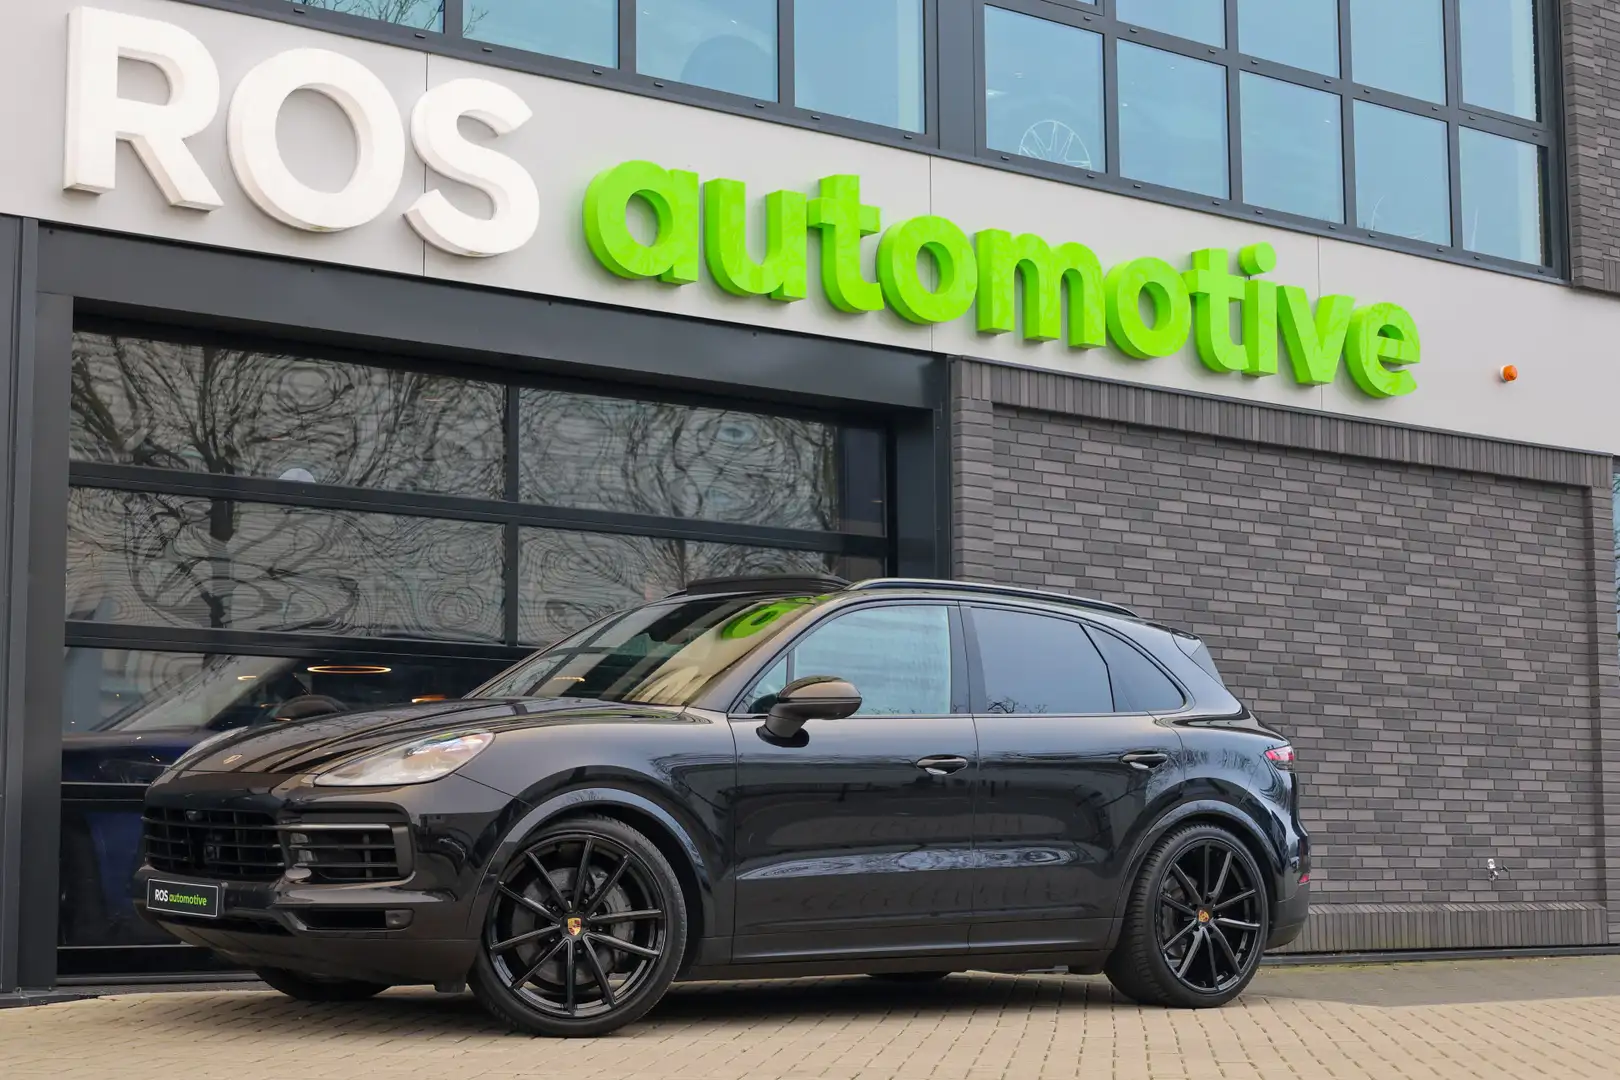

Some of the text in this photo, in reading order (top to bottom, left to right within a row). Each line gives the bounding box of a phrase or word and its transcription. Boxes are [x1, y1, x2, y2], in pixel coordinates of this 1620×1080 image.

[63, 6, 1421, 398] ROS automotive
[154, 888, 207, 906] ROS automotive
